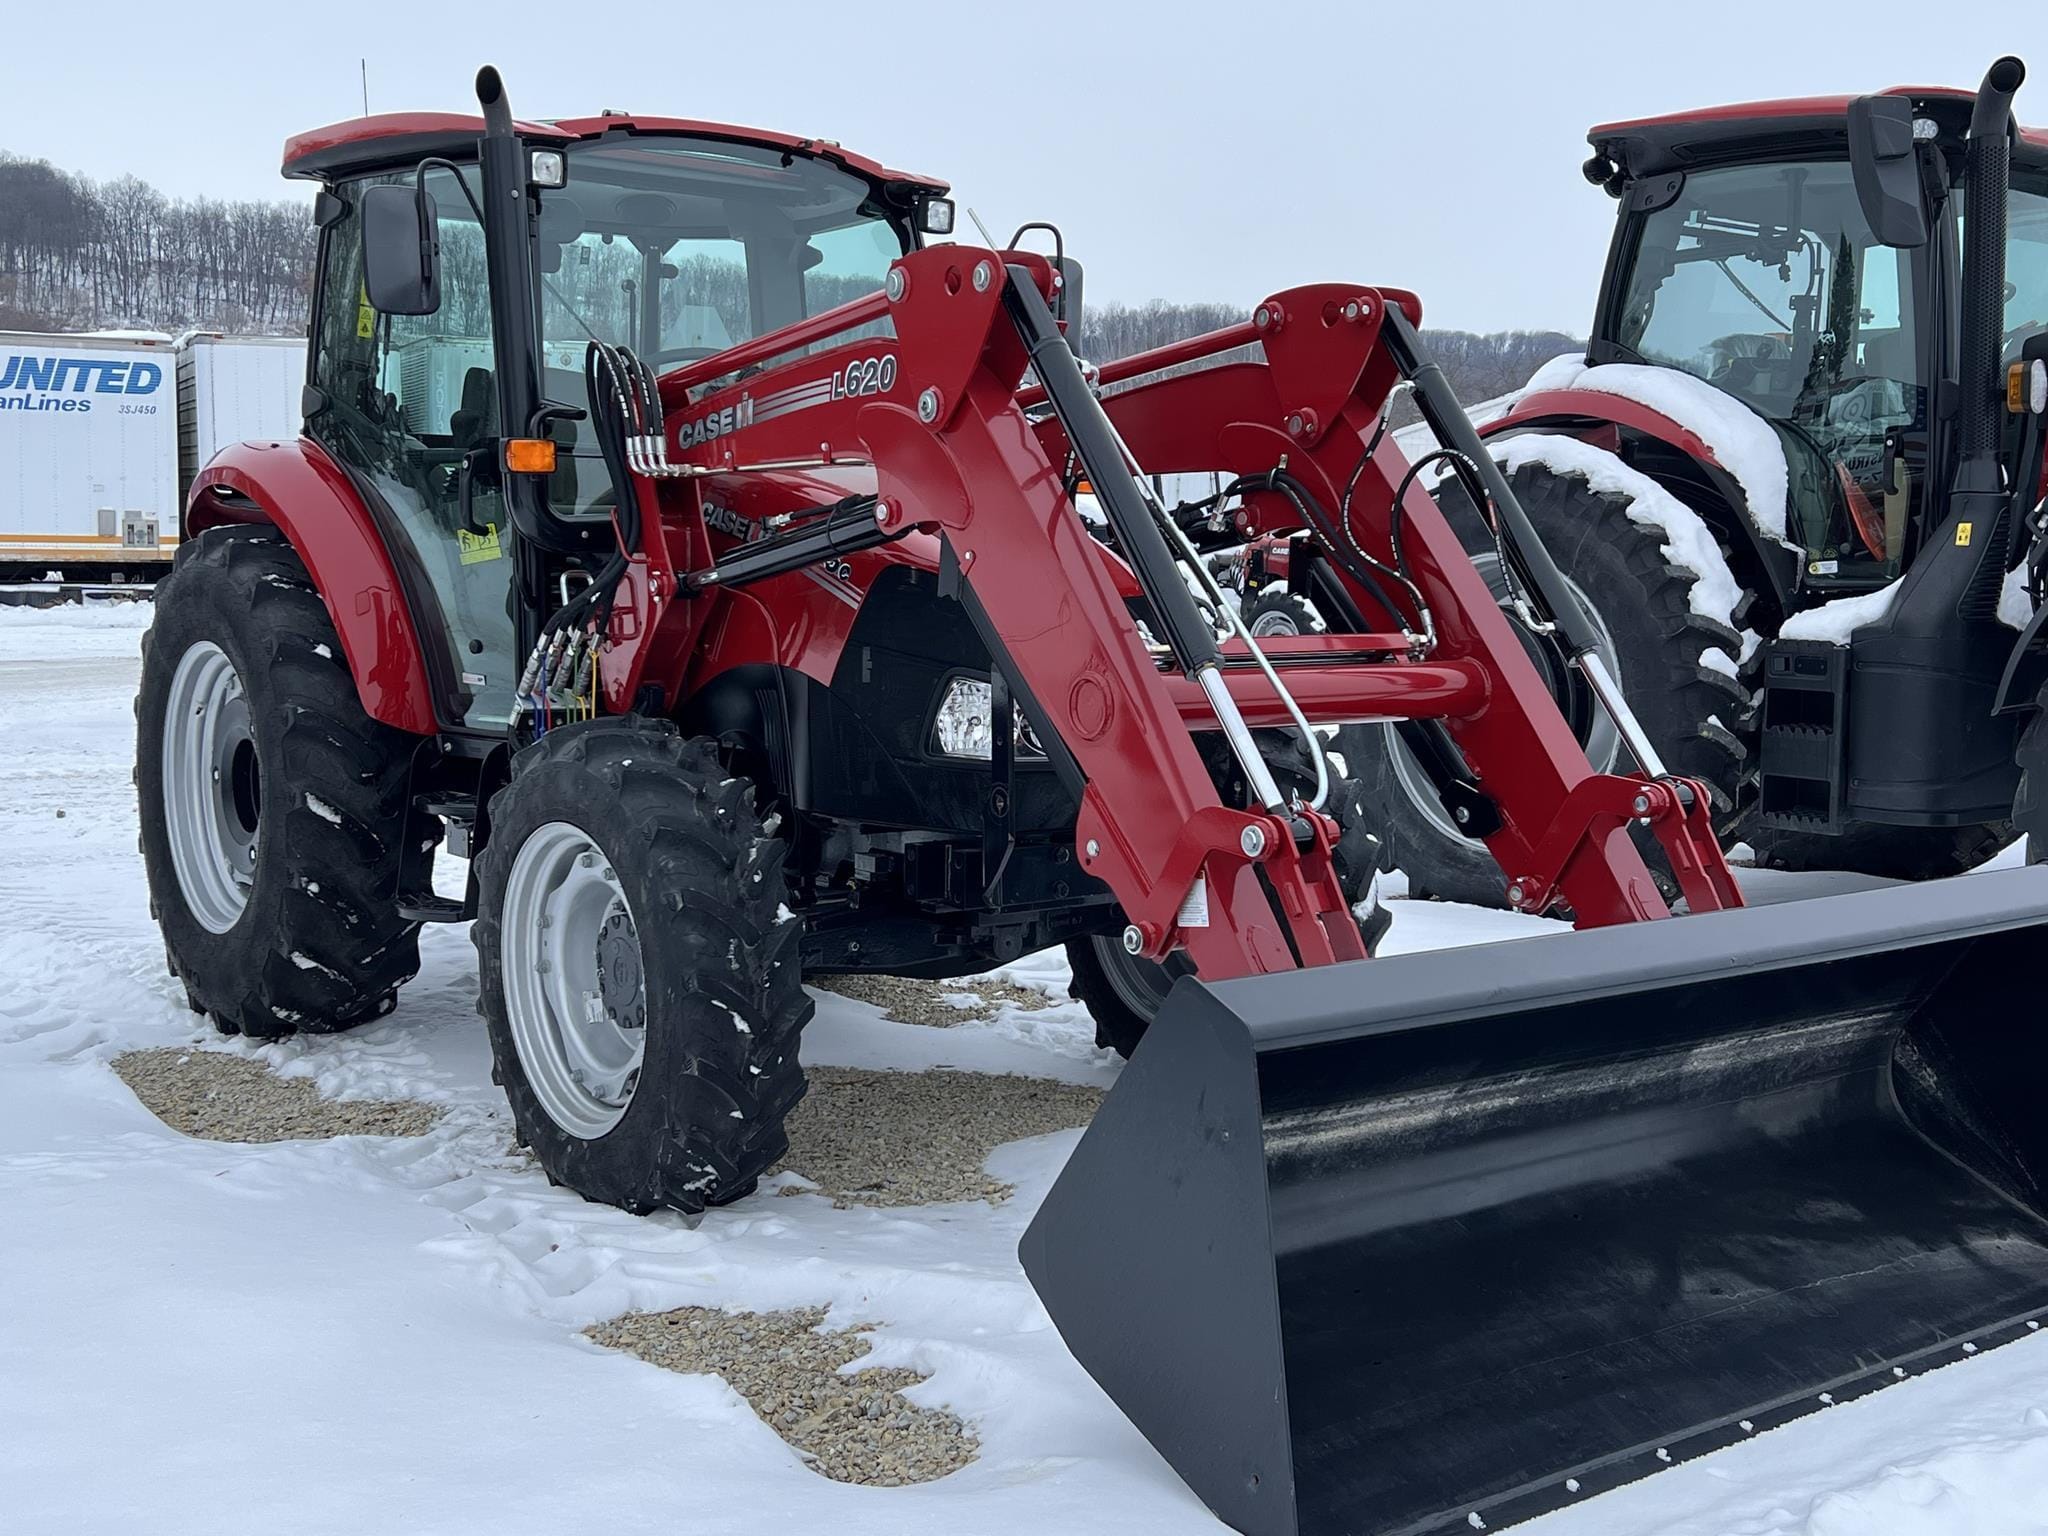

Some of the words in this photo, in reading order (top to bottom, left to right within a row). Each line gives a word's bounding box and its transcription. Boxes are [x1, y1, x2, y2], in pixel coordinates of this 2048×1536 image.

[678, 407, 733, 450] CASE
[831, 353, 898, 401] L620
[702, 502, 748, 540] CASE
